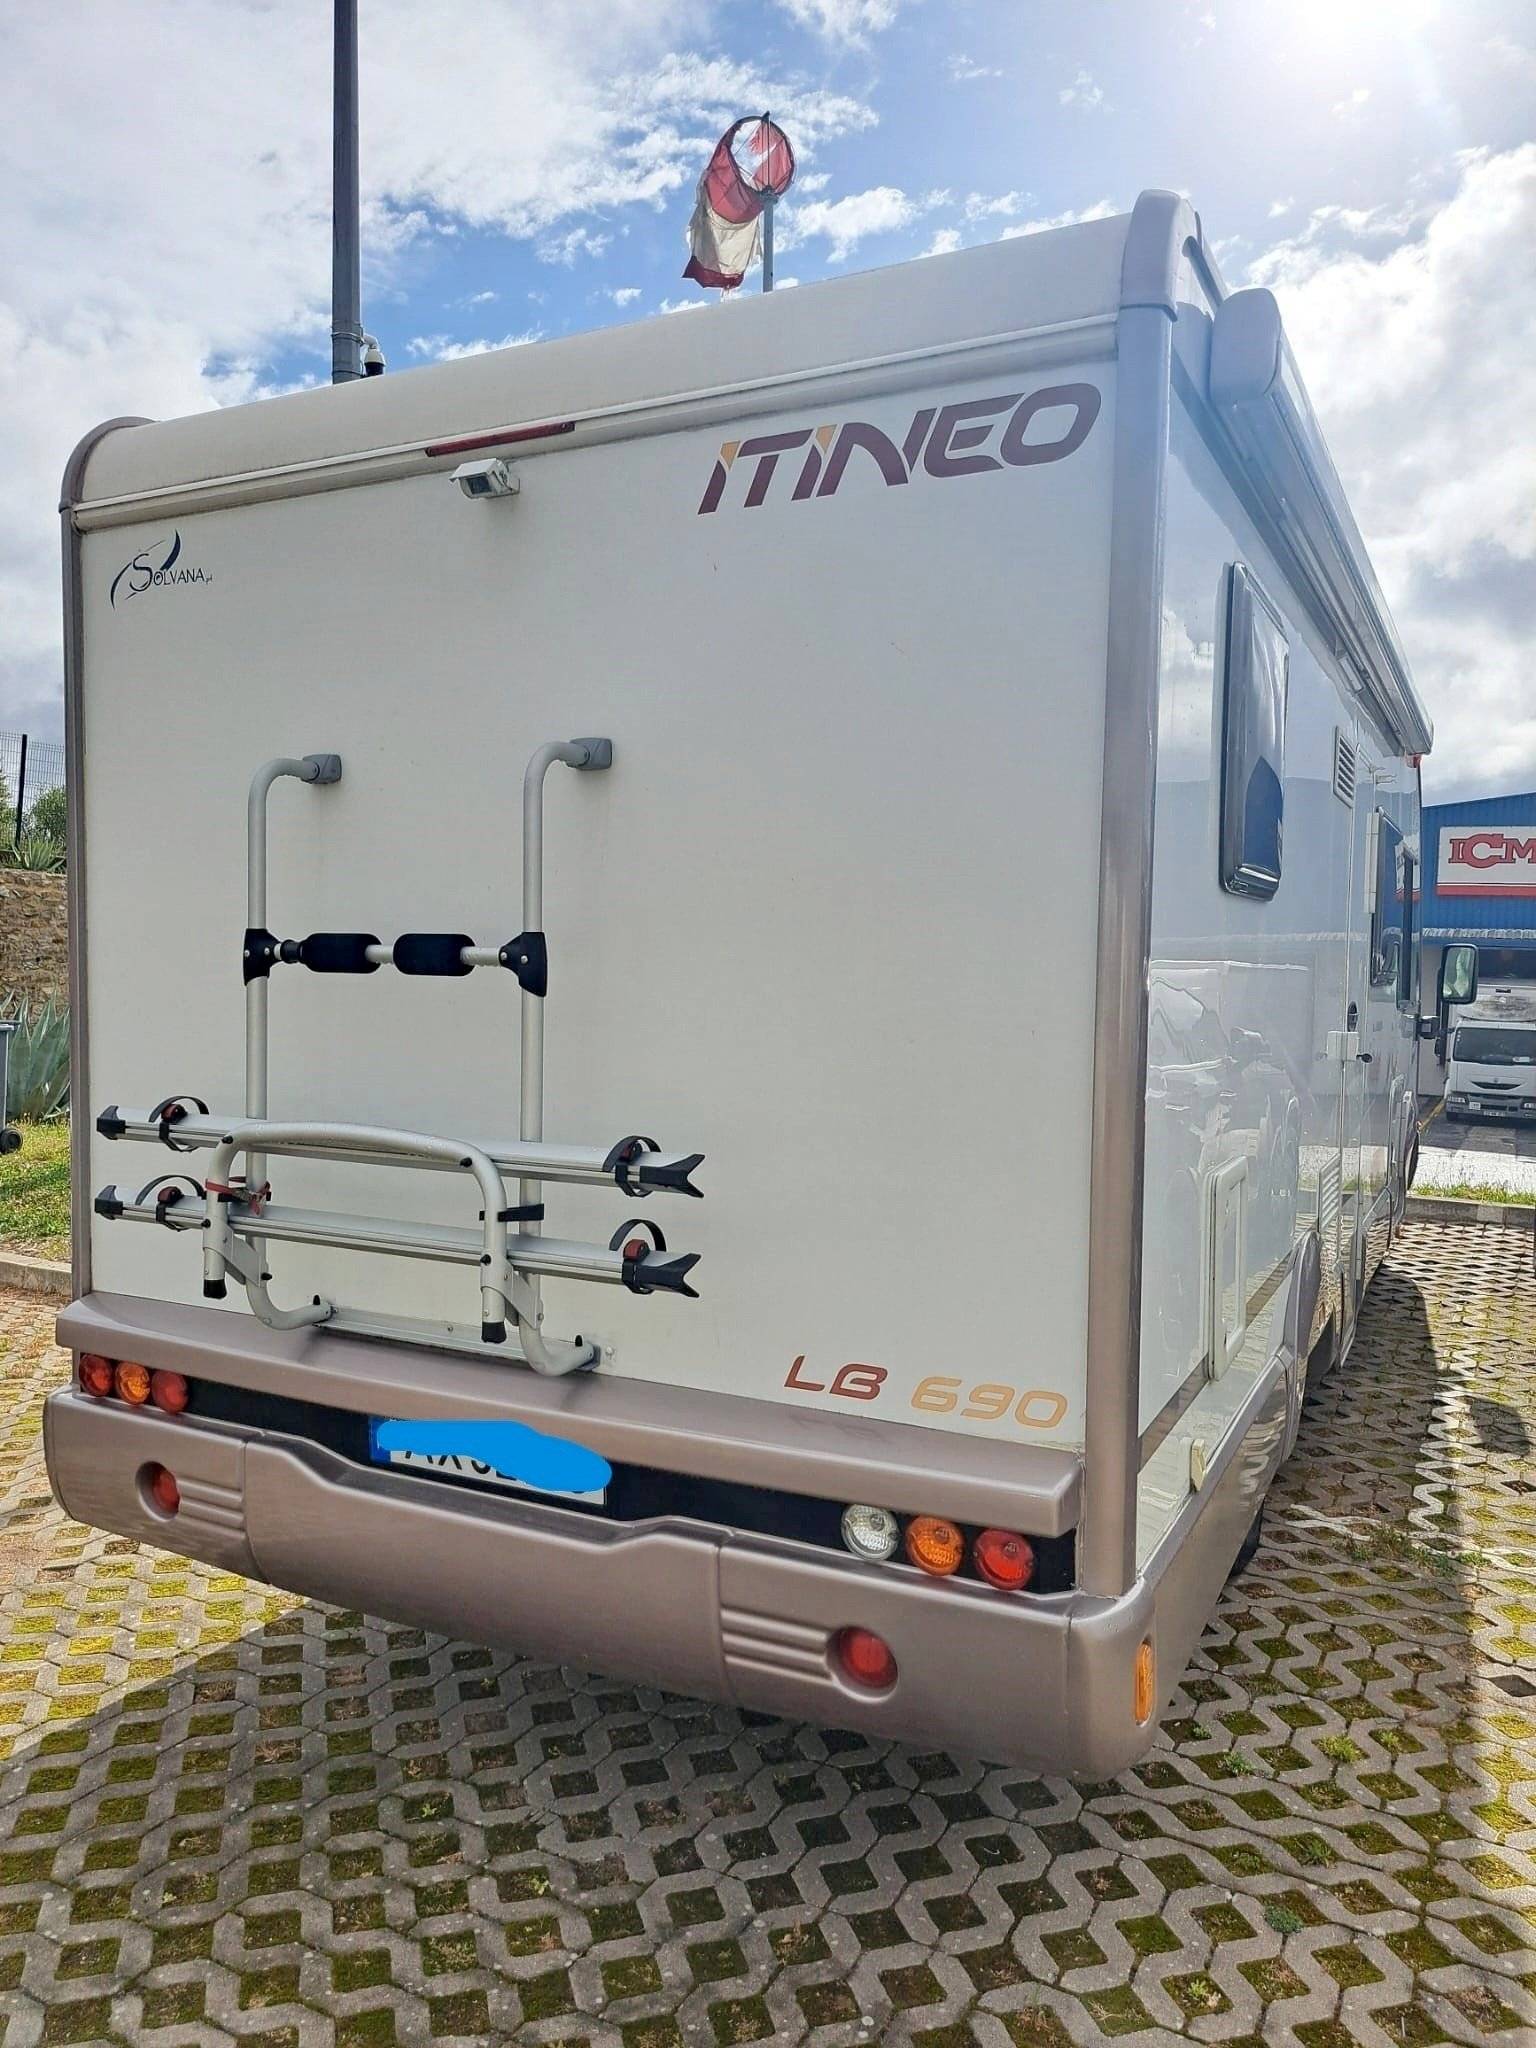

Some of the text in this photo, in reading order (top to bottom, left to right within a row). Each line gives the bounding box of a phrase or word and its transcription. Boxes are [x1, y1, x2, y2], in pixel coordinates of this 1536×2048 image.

[697, 382, 1102, 516] ITINEO
[129, 553, 205, 592] SOLVANA
[783, 1354, 1069, 1429] LB 690
